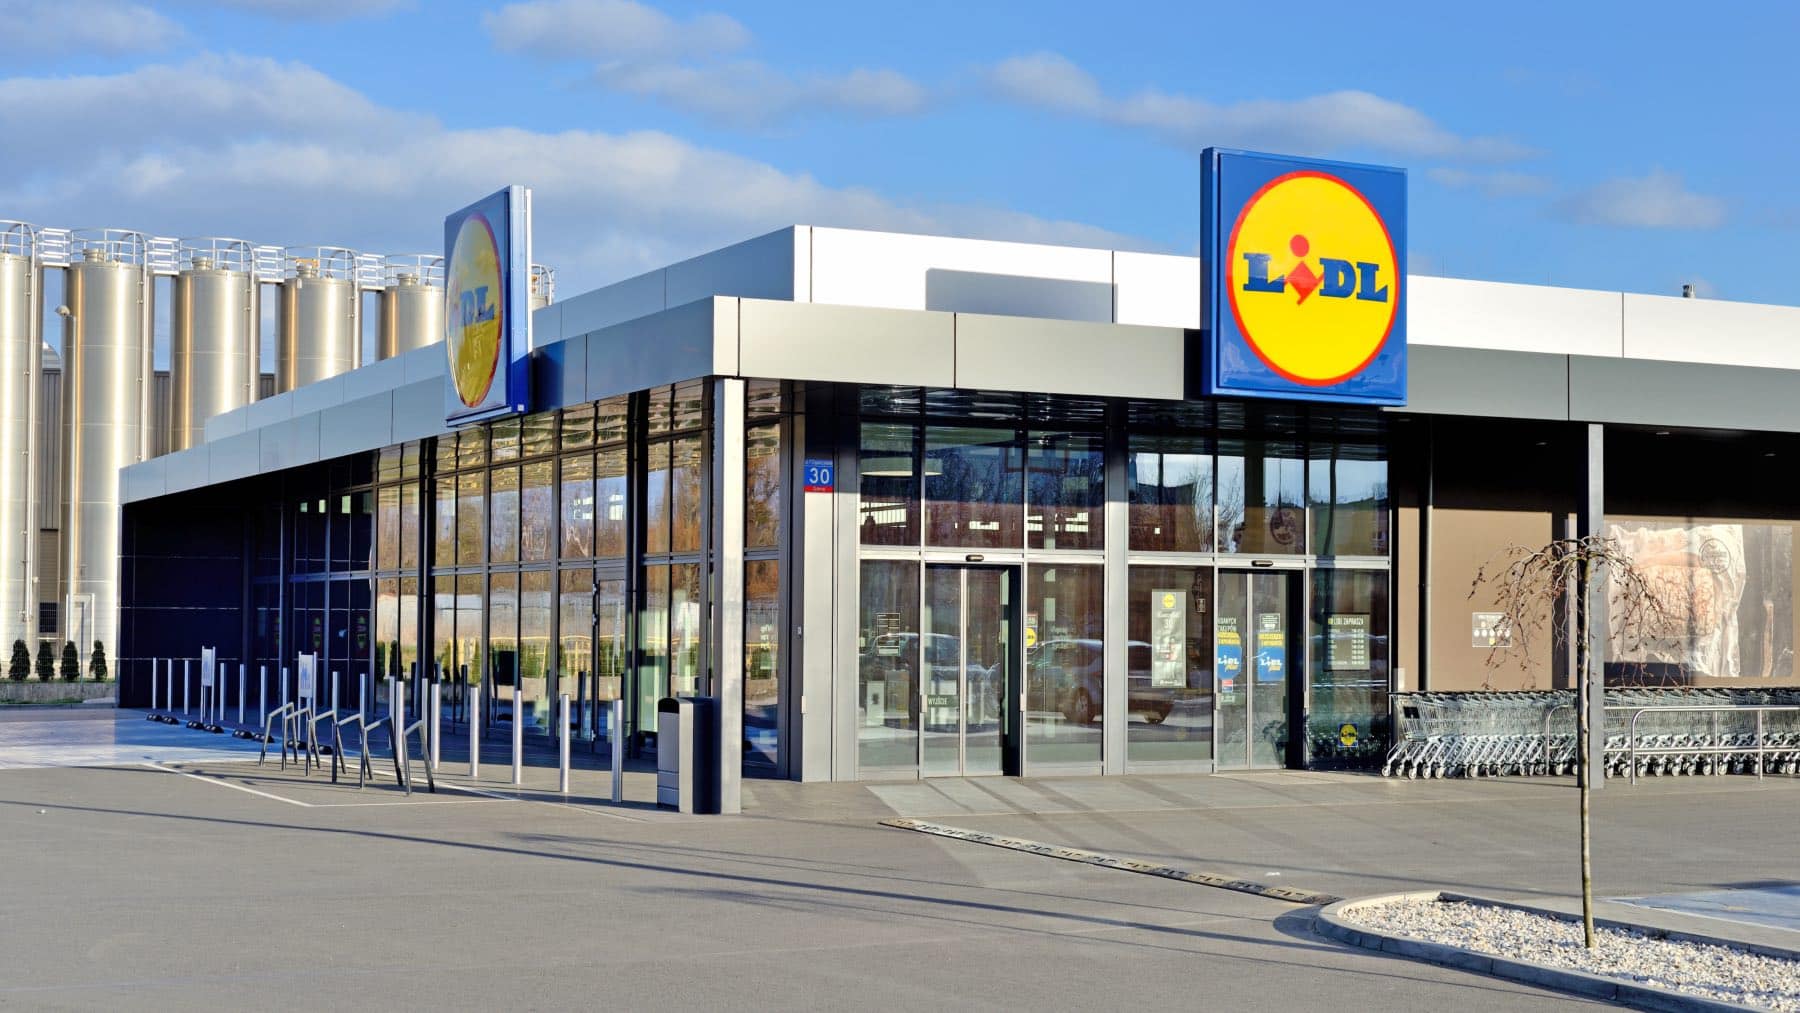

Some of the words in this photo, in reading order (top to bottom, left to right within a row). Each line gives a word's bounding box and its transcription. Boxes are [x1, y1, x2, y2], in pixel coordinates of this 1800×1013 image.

[1243, 234, 1388, 305] LIDL
[456, 284, 494, 327] DL
[809, 467, 830, 484] 30
